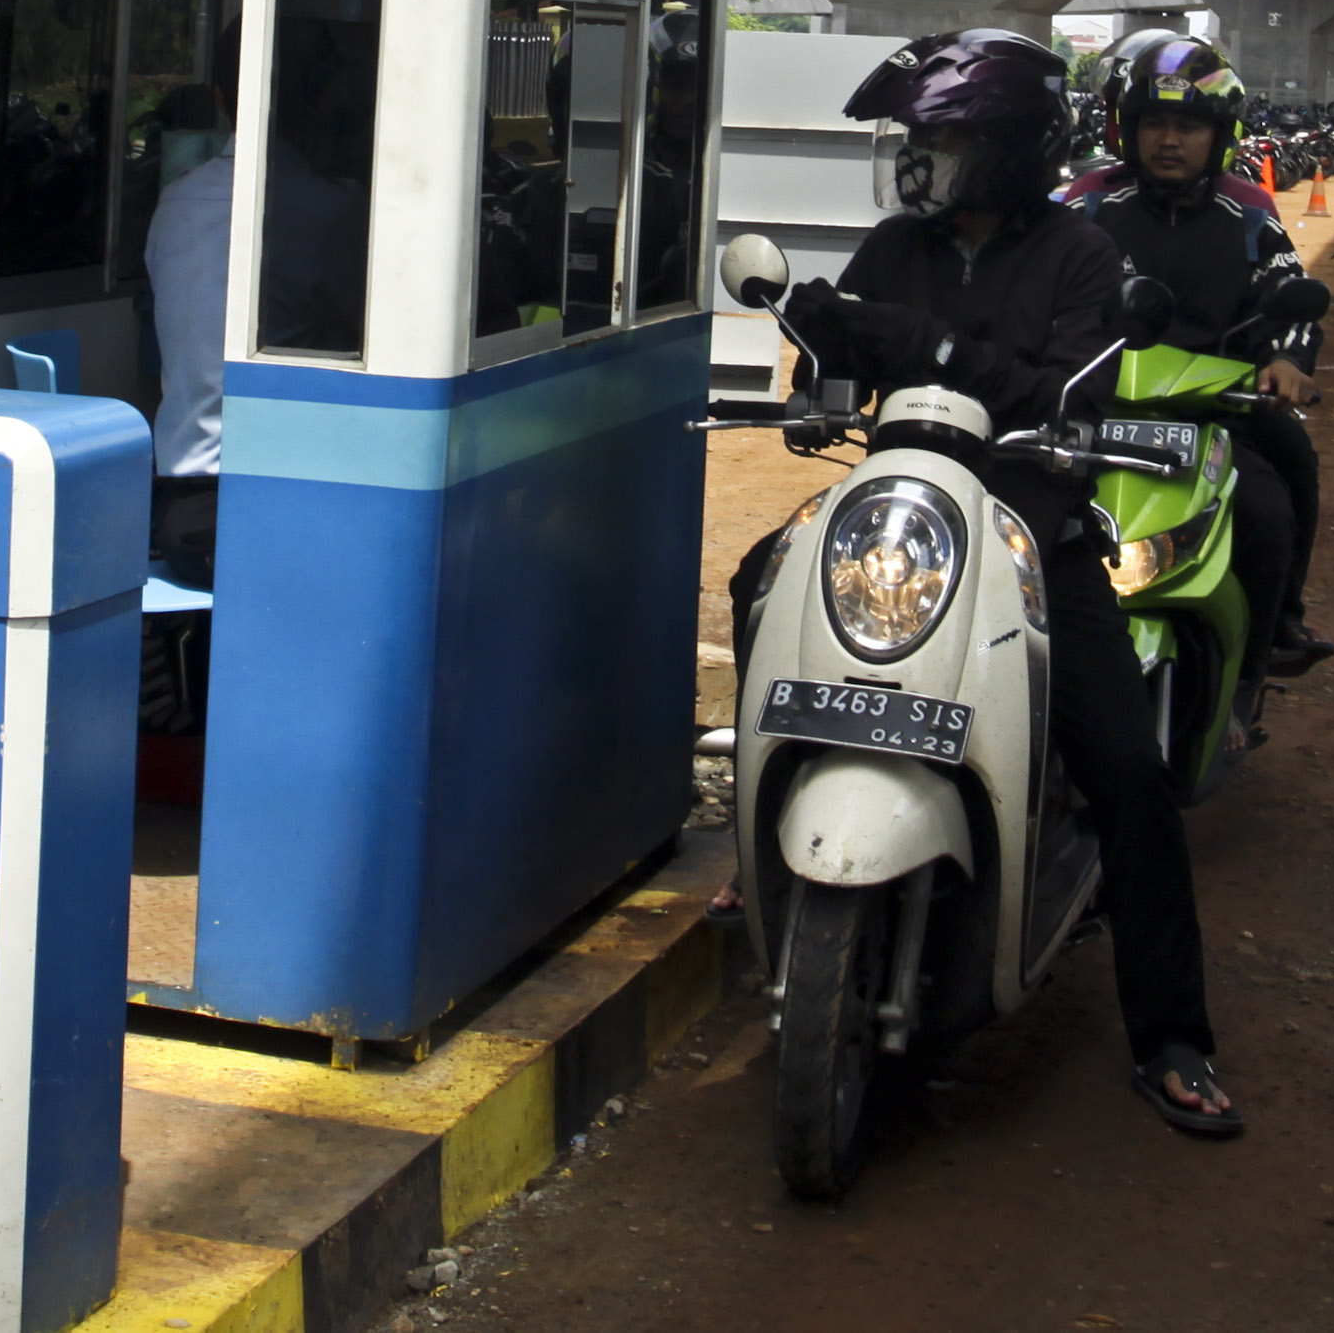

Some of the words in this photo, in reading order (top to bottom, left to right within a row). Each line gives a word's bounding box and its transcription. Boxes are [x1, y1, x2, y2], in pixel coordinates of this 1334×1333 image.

[906, 402, 952, 414] HONDA
[771, 682, 793, 706] B
[813, 686, 889, 717] 3463
[909, 699, 965, 731] SIS
